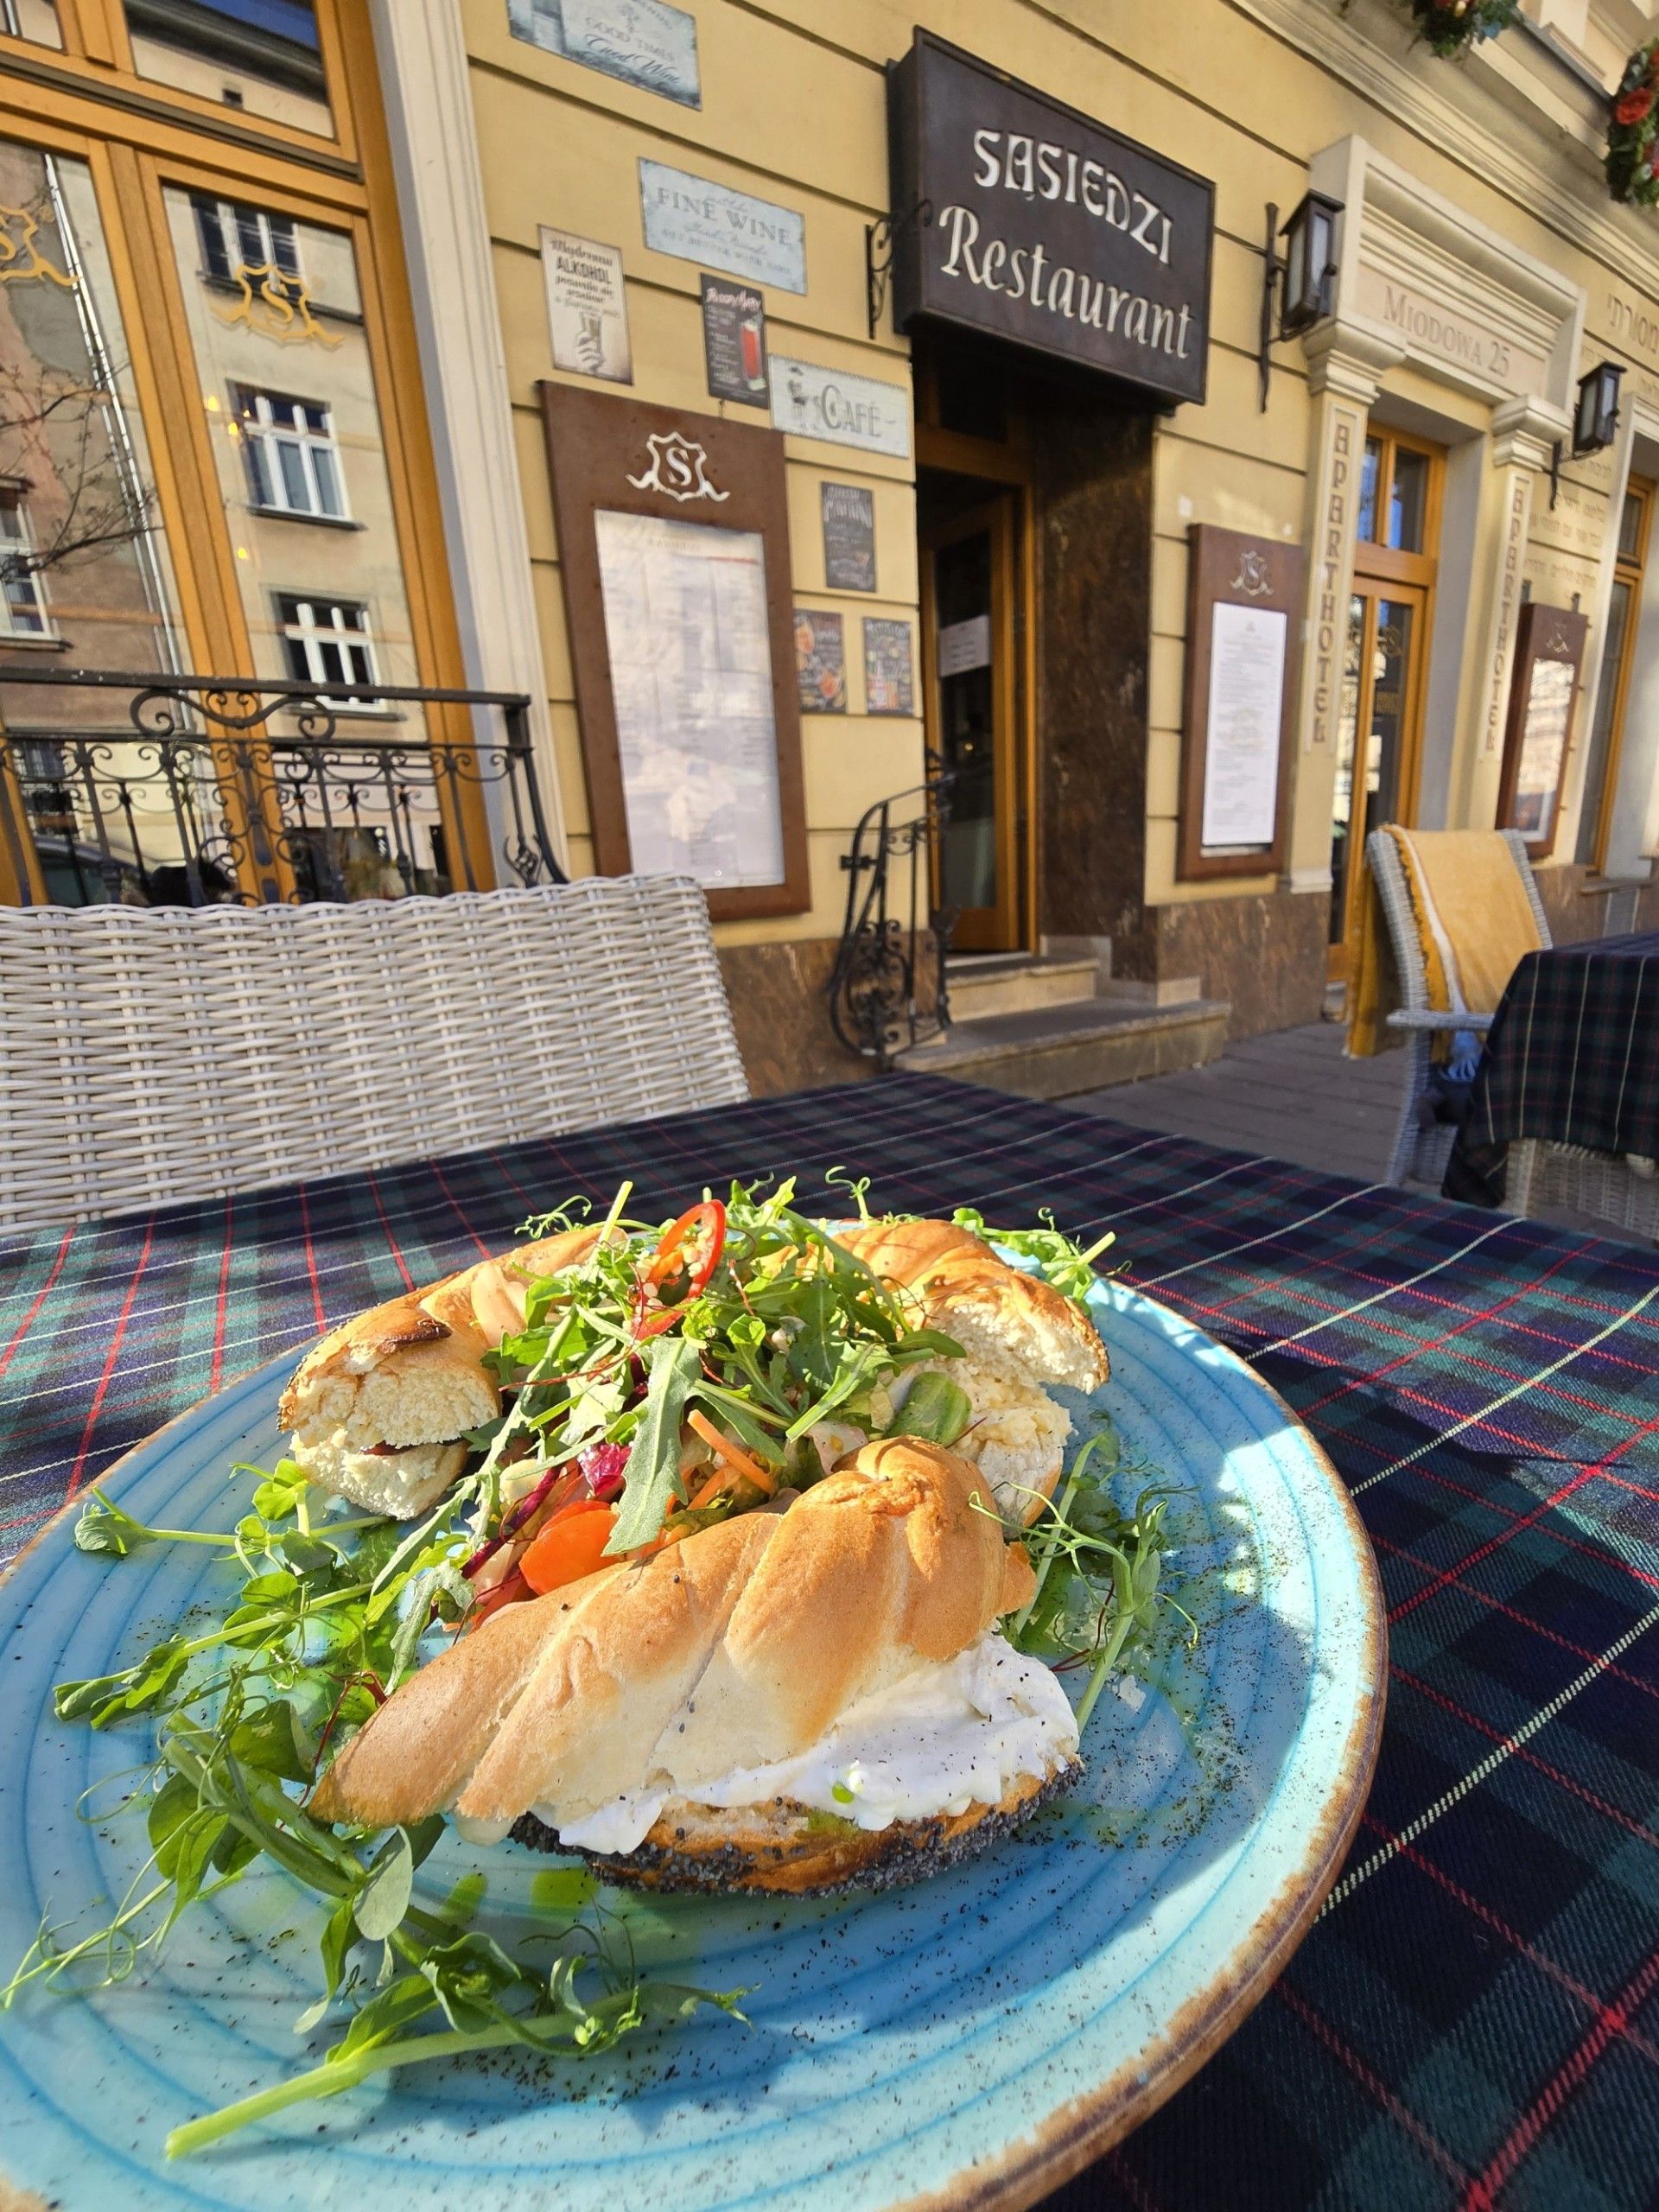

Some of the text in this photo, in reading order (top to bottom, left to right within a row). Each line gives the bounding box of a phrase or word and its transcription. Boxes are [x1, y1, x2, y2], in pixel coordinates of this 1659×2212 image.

[657, 186, 718, 222] FINE
[725, 209, 791, 246] WINE
[973, 127, 1174, 266] SĄSIEDZI
[938, 204, 1194, 359] Restaurant
[1384, 284, 1511, 378] MIODOWA 25
[665, 446, 692, 488] S
[1312, 423, 1351, 745] APARTHOTEL
